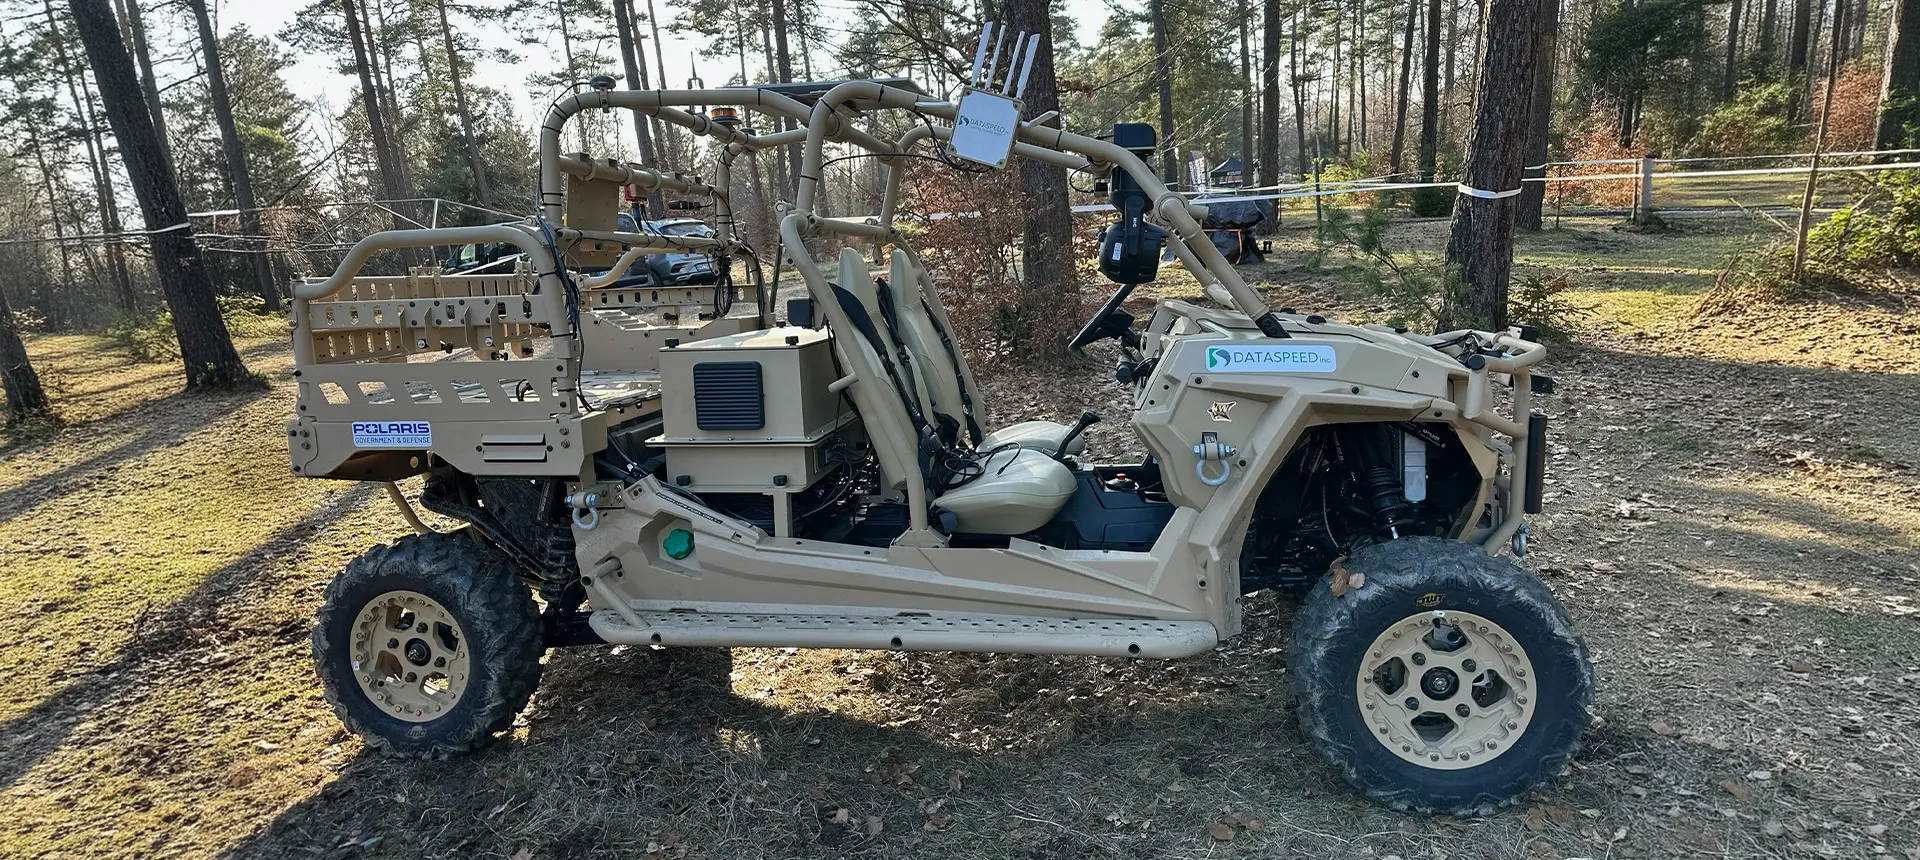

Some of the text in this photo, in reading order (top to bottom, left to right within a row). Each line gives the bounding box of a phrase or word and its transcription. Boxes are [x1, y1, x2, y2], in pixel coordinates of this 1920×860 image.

[970, 119, 1005, 133] DATASPEED
[1233, 351, 1319, 363] DATASPEED
[353, 423, 430, 433] POLARIS
[355, 436, 396, 444] GOVERNMENT
[396, 436, 402, 444] &
